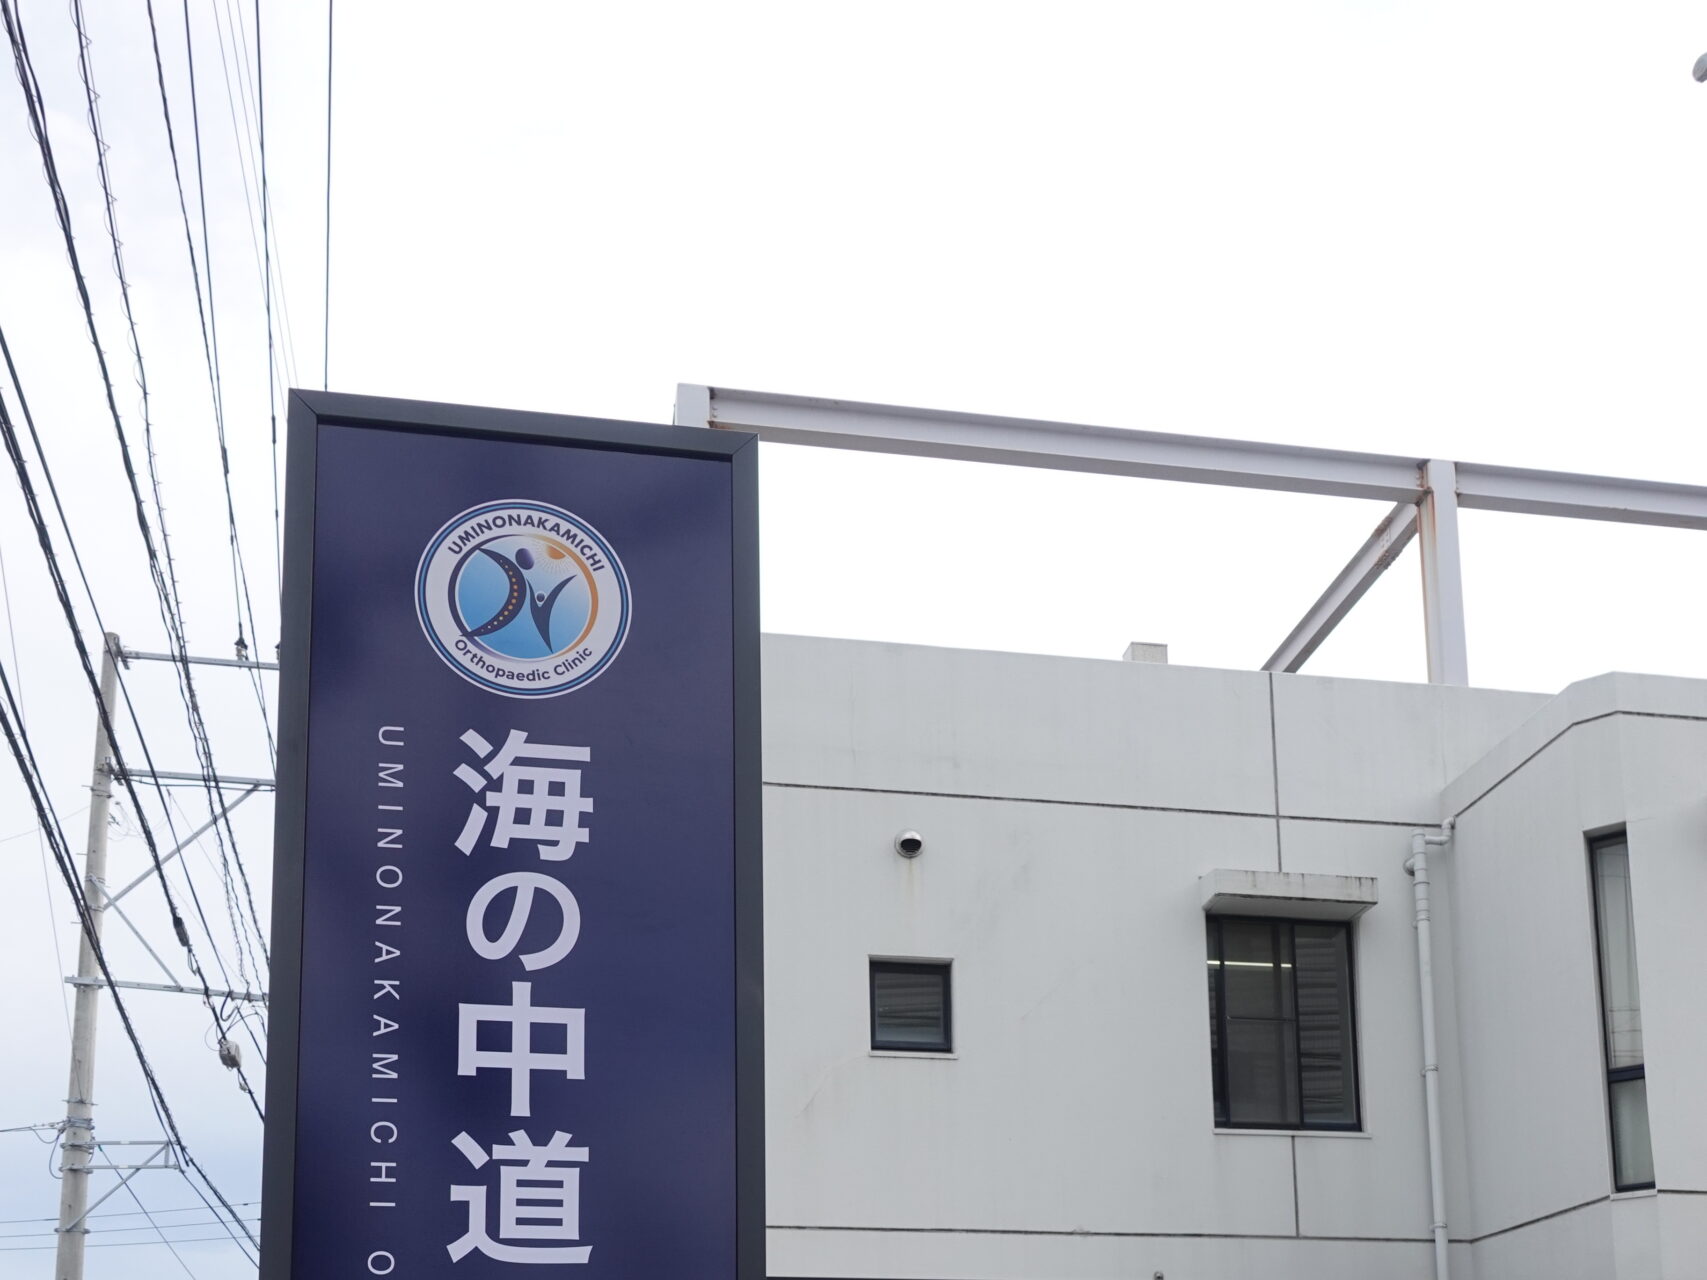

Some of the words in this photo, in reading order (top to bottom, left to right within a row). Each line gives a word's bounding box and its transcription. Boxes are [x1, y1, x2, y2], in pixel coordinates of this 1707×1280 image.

[448, 513, 605, 572] UMINONAKAMICHI
[454, 639, 551, 681] Orthopaedic
[553, 647, 593, 676] Clinic
[370, 725, 405, 1208] UMINONAKAMICHI
